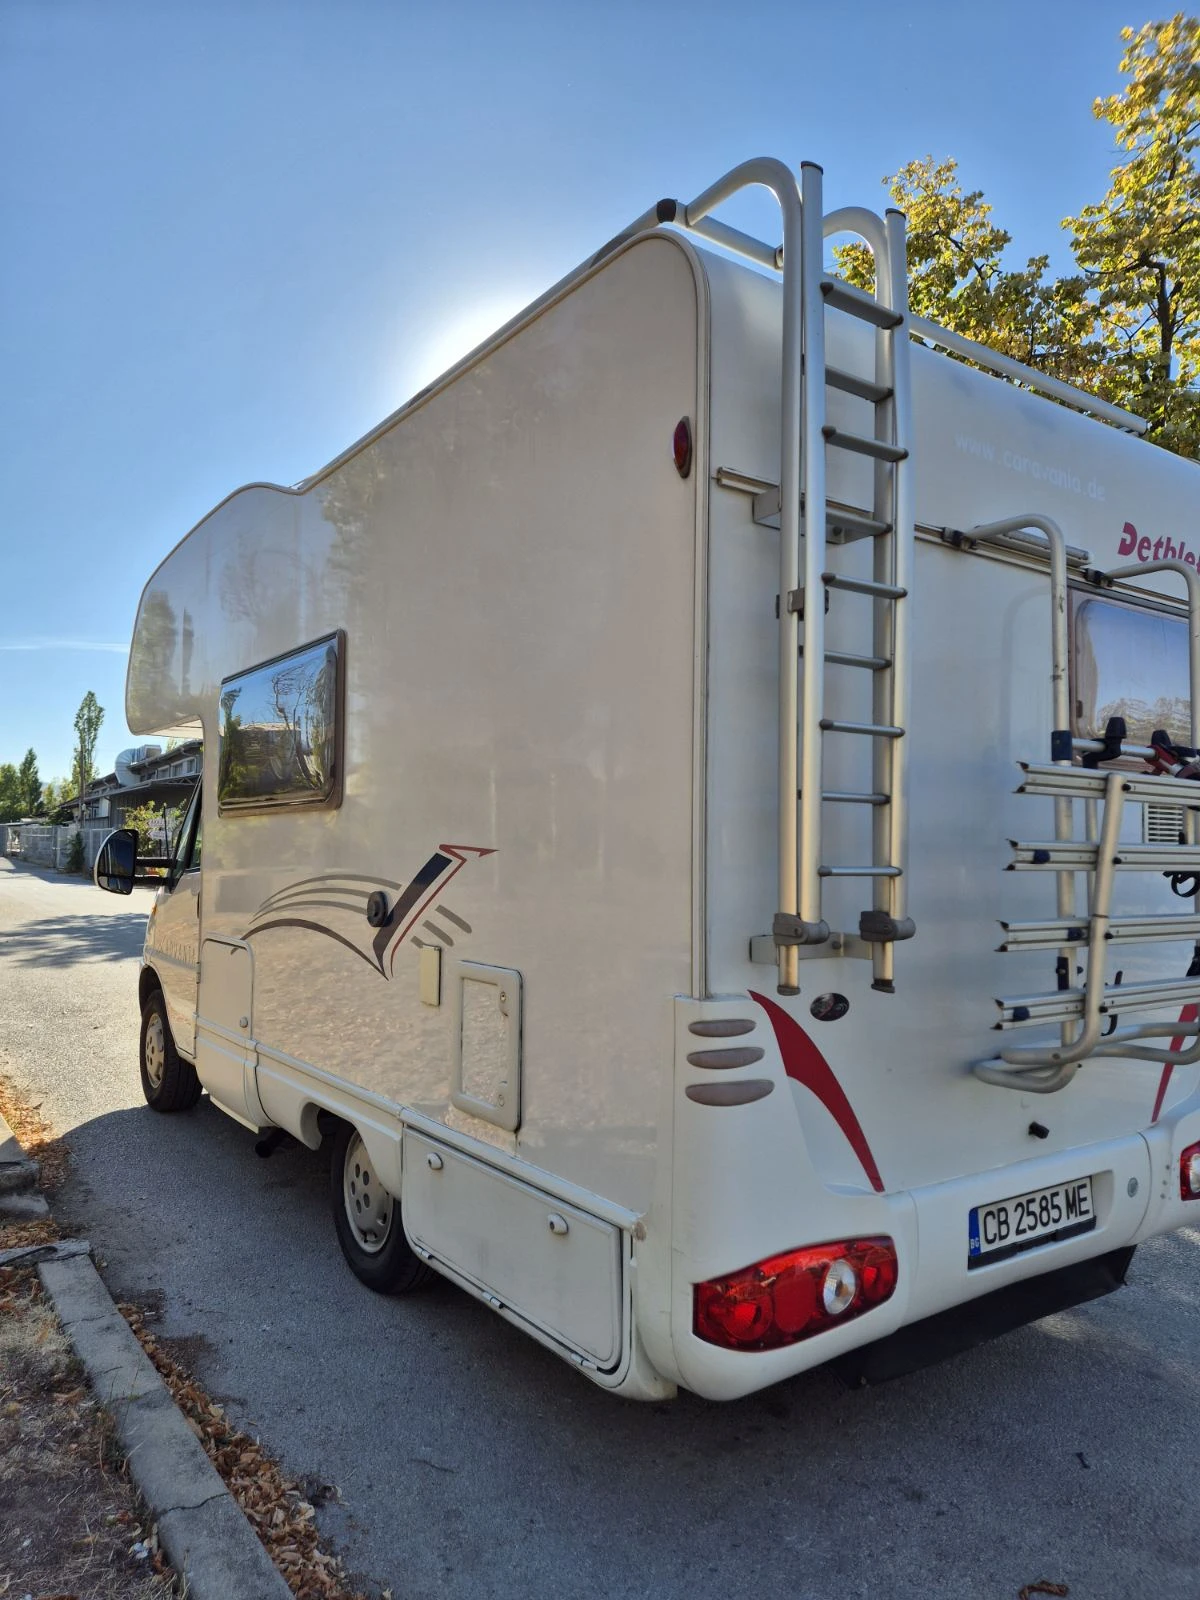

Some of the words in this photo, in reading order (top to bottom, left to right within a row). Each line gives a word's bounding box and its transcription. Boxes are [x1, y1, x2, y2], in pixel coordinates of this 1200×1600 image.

[983, 1206, 1010, 1245] CB
[1013, 1191, 1062, 1236] 2585
[1065, 1183, 1090, 1220] ME
